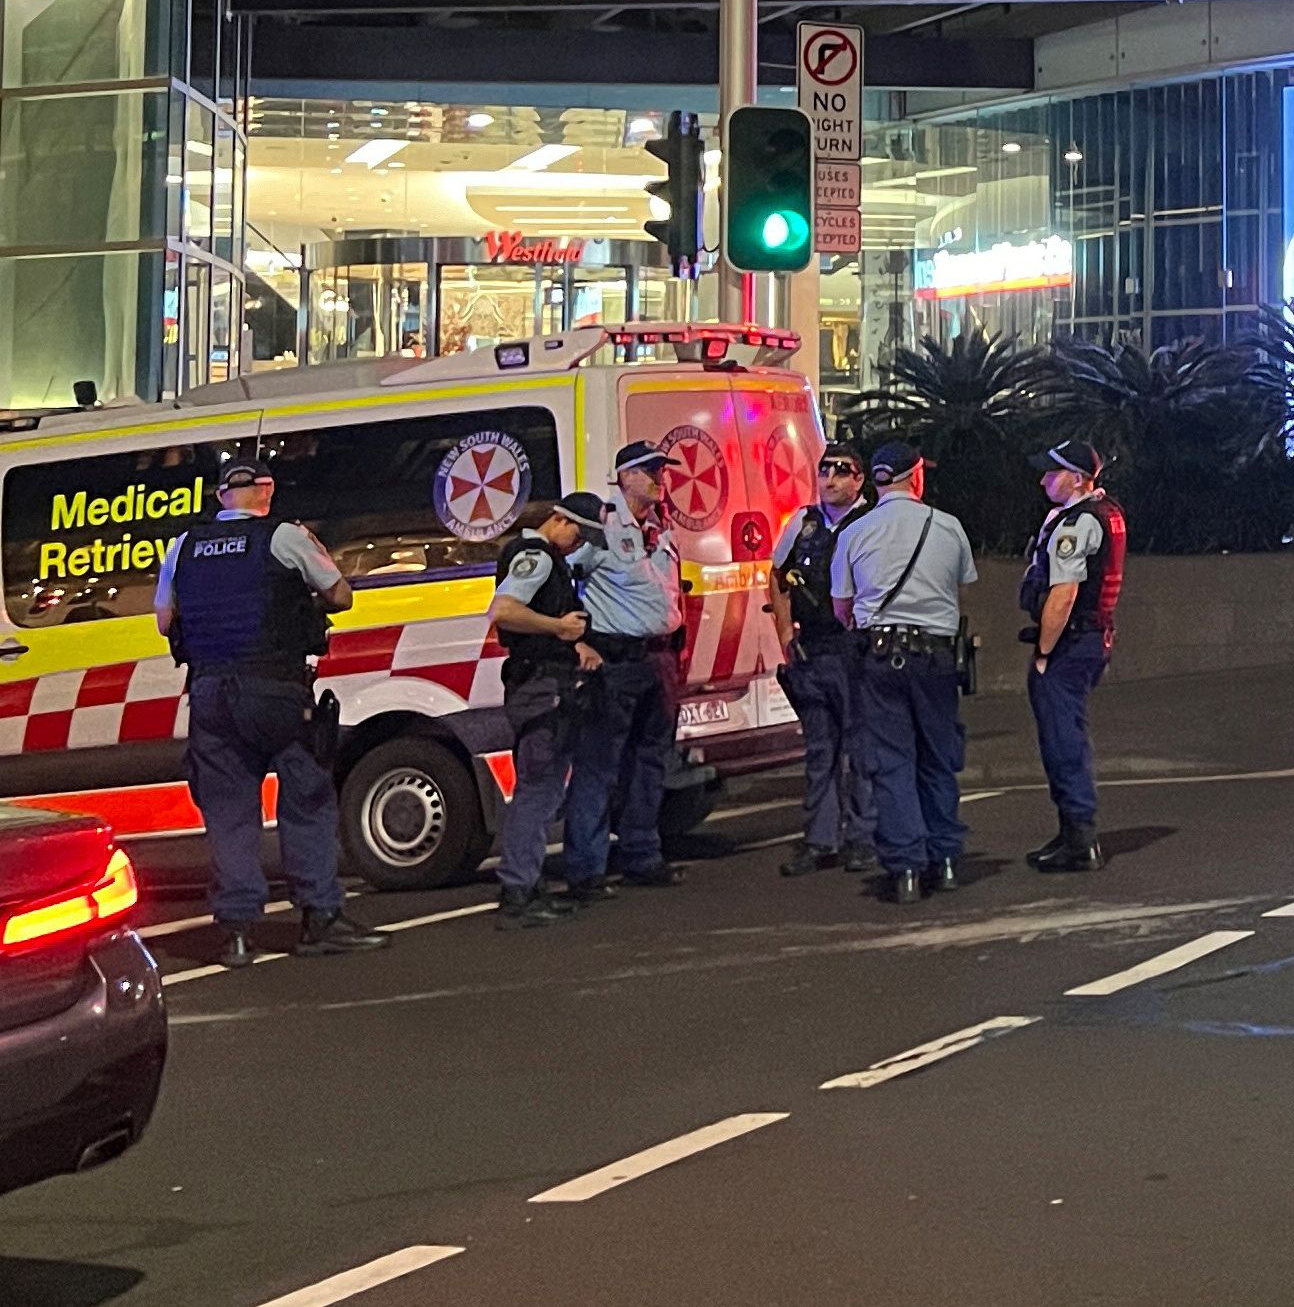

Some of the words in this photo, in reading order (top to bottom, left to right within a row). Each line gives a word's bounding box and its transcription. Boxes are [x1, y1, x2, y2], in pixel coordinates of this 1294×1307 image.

[813, 91, 847, 112] NO
[817, 170, 849, 183] USES
[816, 186, 856, 200] CEPTED
[815, 215, 856, 229] CYCLES
[815, 234, 857, 246] CEPTED
[438, 445, 460, 478] NEW
[459, 431, 500, 452] SOUTH
[500, 433, 530, 472] WALES
[50, 476, 204, 531] Medical
[39, 532, 178, 580] Retriev
[193, 540, 246, 558] POLICE
